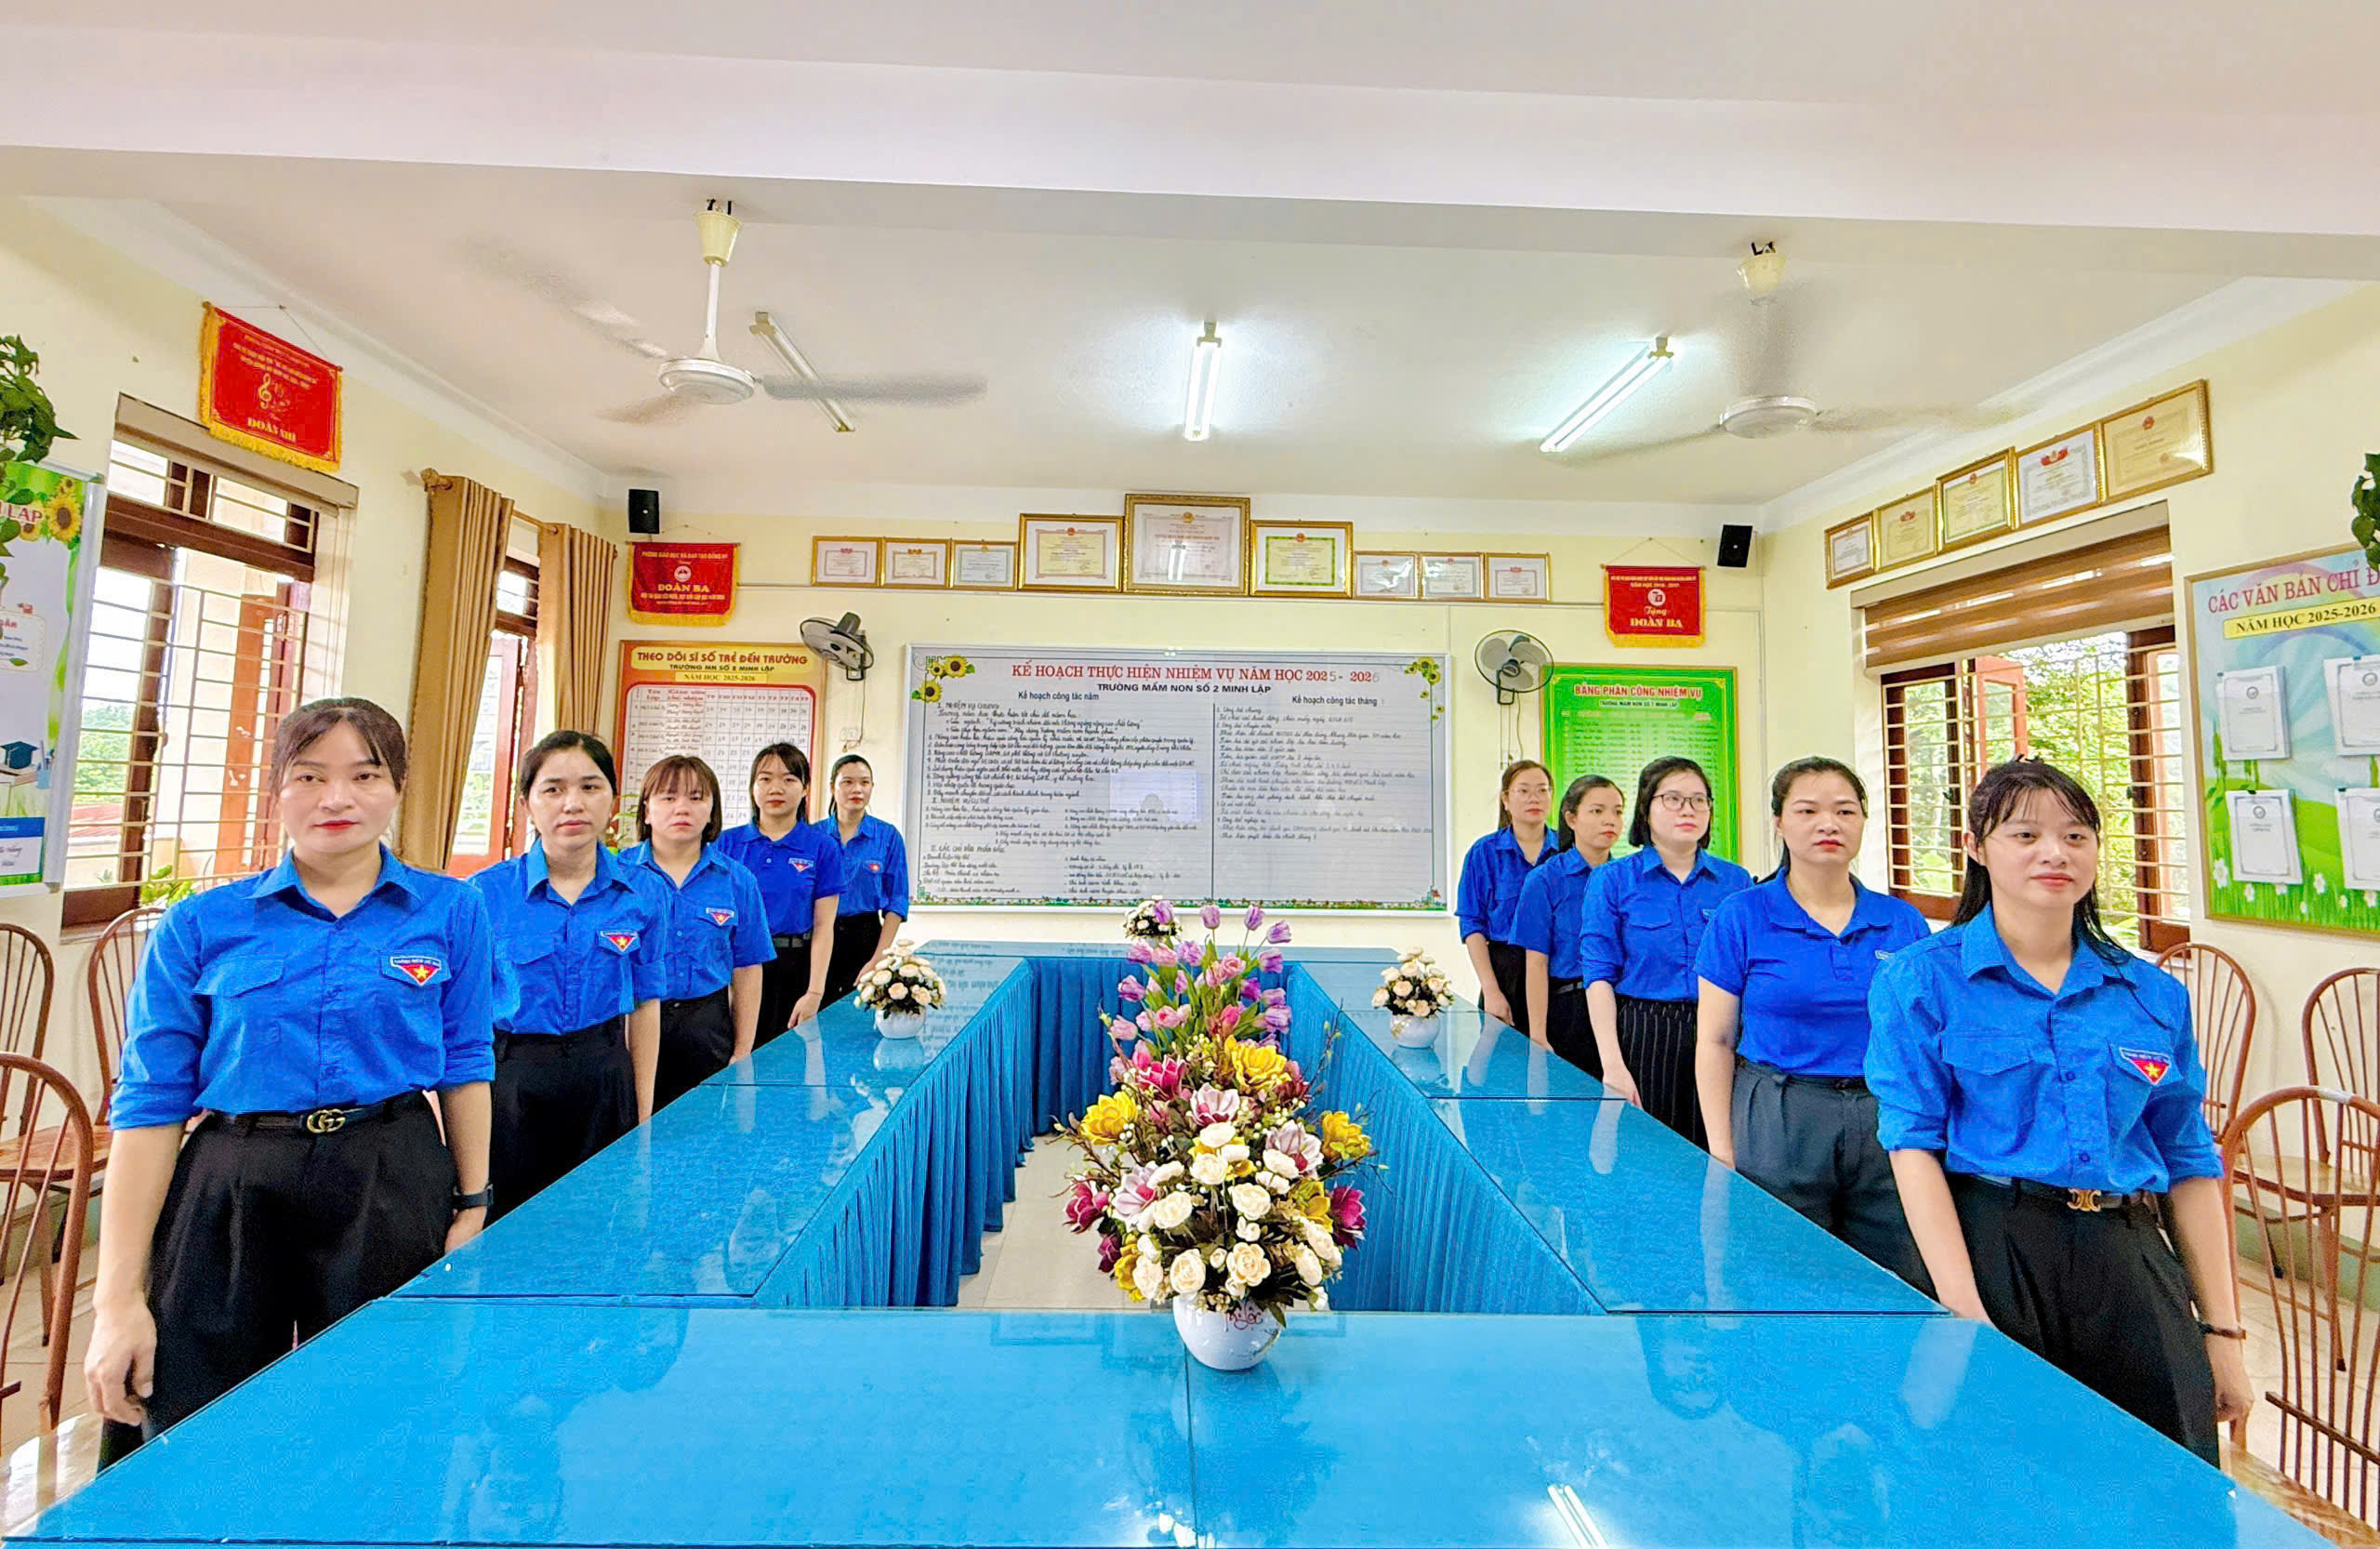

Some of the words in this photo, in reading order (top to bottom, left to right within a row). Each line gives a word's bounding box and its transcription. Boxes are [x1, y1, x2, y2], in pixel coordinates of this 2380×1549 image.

[657, 582, 691, 591] ĐOÀN
[693, 584, 710, 592] BA
[2207, 589, 2240, 614] CÁC
[2241, 581, 2279, 607] VĂN
[2283, 571, 2322, 601] BẢN
[2327, 560, 2360, 592] CHỈ
[1630, 616, 1664, 628] ĐOÀN
[1666, 617, 1683, 629] BA
[2235, 616, 2268, 634] NĂM
[2272, 613, 2306, 629] HỌC
[2308, 602, 2377, 624] 2025-2026
[637, 652, 664, 661] THEO
[667, 651, 687, 661] DÕI
[701, 650, 717, 662] SỐ
[719, 651, 737, 663] TRẺ
[739, 652, 760, 663] ĐẾN
[762, 654, 808, 664] TRƯỜNG
[1012, 659, 1033, 677] KẾ
[1035, 664, 1084, 681] HOẠCH
[1087, 665, 1124, 681] THỰC
[1126, 663, 1161, 682] HIỆN
[1165, 664, 1212, 682] NHIỆM
[1215, 668, 1236, 682] VỤ
[1238, 666, 1271, 681] NĂM
[1274, 669, 1302, 683] HỌC
[1097, 682, 1139, 692] TRƯỜNG
[1196, 682, 1210, 693] SỐ
[1212, 684, 1219, 693] 2
[1222, 684, 1249, 693] MINH
[1250, 683, 1272, 695] LẬP
[1631, 684, 1655, 696] CÔNG
[1029, 692, 1051, 701] hoạch
[1052, 692, 1069, 702] công
[1071, 692, 1082, 700] tác
[1084, 692, 1099, 700] năm
[1303, 696, 1324, 706] hoạch
[1326, 696, 1343, 707] công
[1345, 696, 1355, 705] tác
[1357, 696, 1377, 707] tháng
